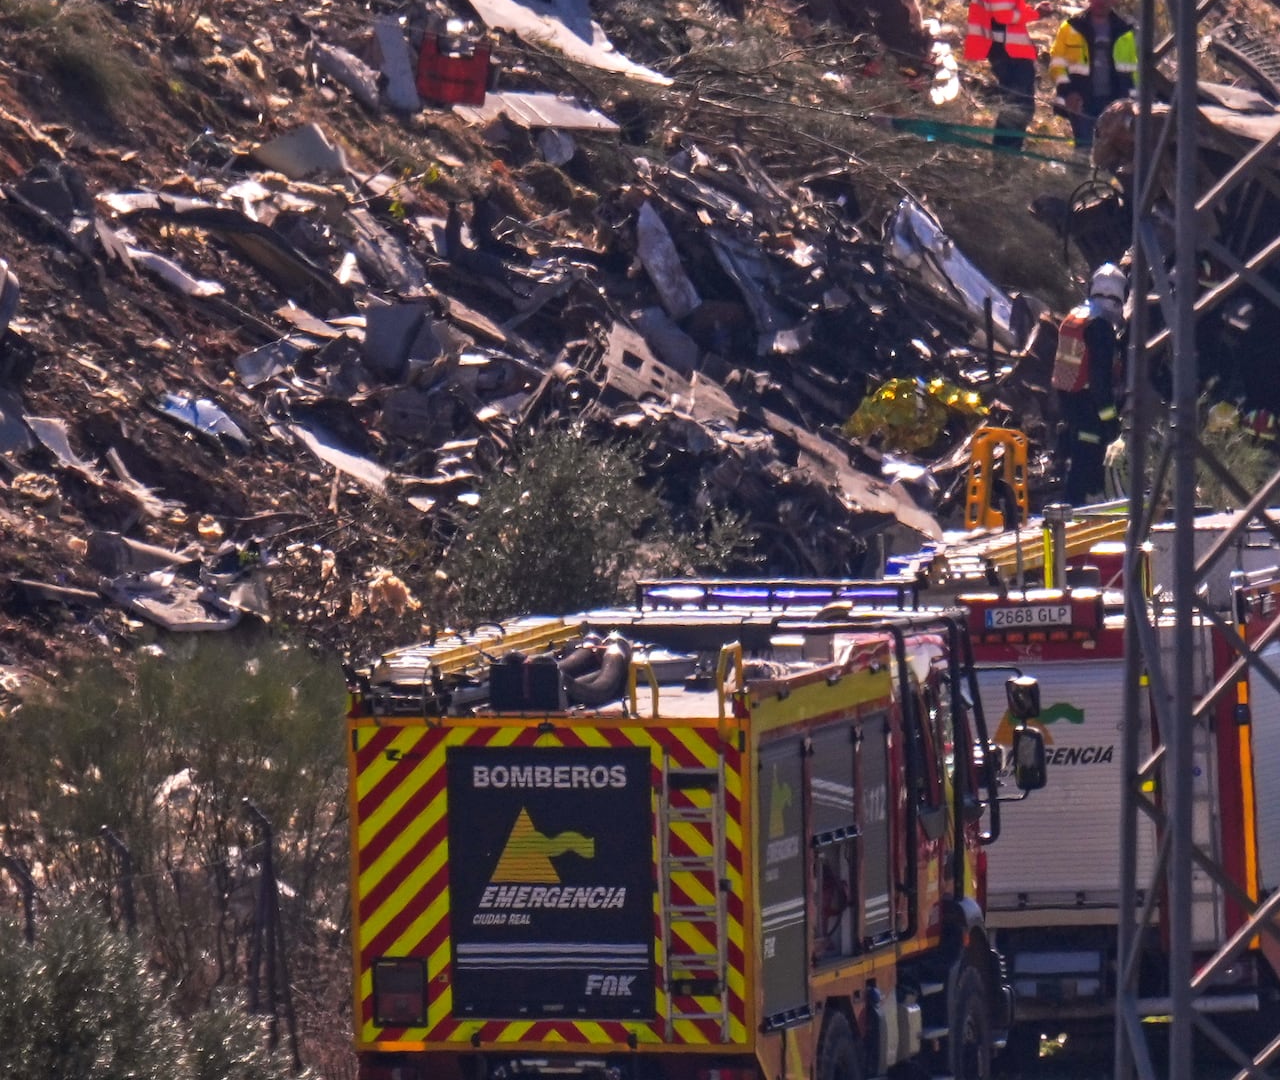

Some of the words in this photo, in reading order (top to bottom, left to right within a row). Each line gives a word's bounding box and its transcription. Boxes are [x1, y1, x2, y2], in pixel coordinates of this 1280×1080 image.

[996, 609, 1033, 625] 2668
[1038, 608, 1067, 622] GLP
[474, 766, 626, 788] BOMBEROS
[479, 886, 626, 908] EMERGENCIA
[473, 914, 506, 925] CIUDAD
[508, 914, 531, 925] REAL
